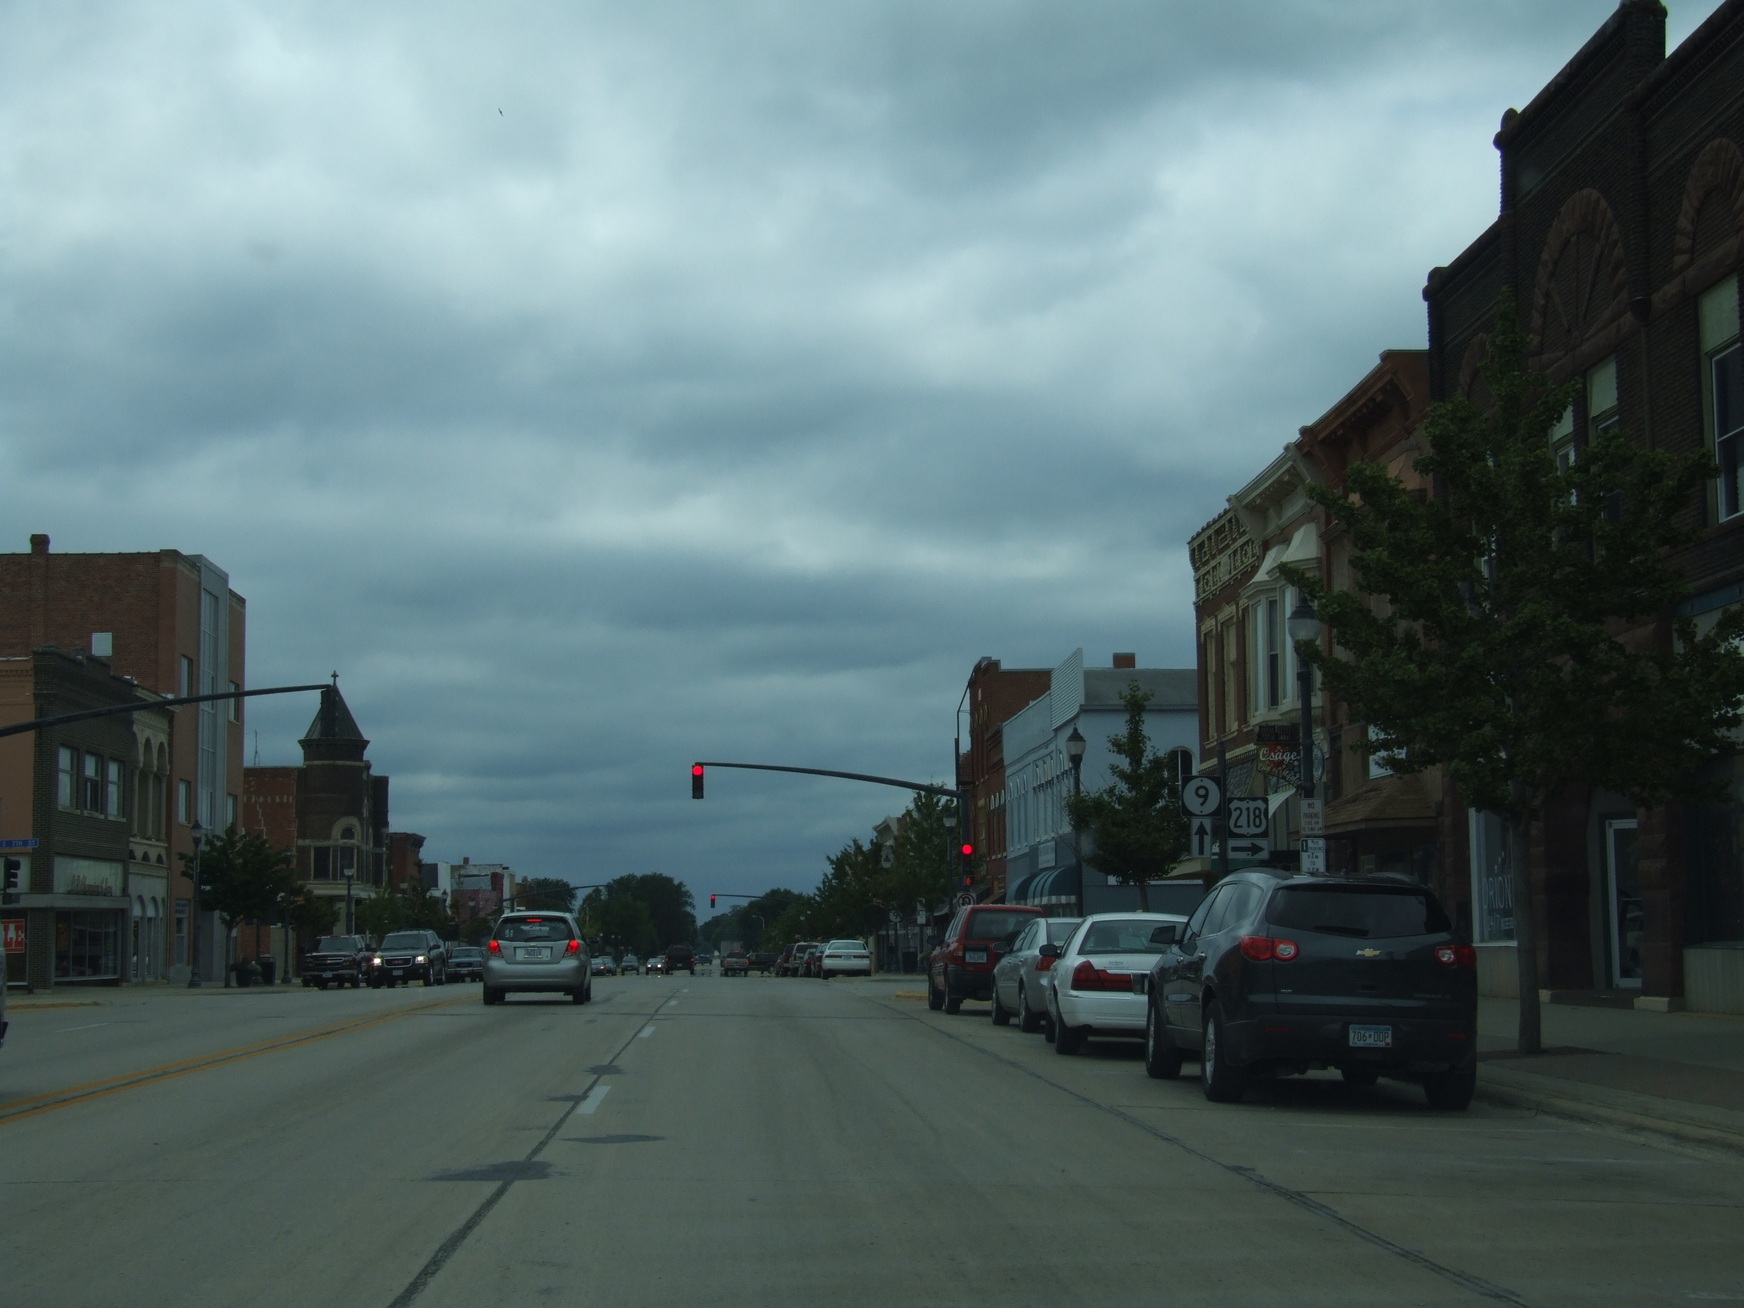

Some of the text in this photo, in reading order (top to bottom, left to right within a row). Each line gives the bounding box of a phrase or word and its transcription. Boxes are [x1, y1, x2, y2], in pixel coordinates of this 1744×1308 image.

[1259, 747, 1298, 765] Osage
[1195, 785, 1209, 807] 9
[1233, 807, 1262, 828] 218
[1482, 875, 1512, 909] ORION
[1351, 1031, 1367, 1042] 706
